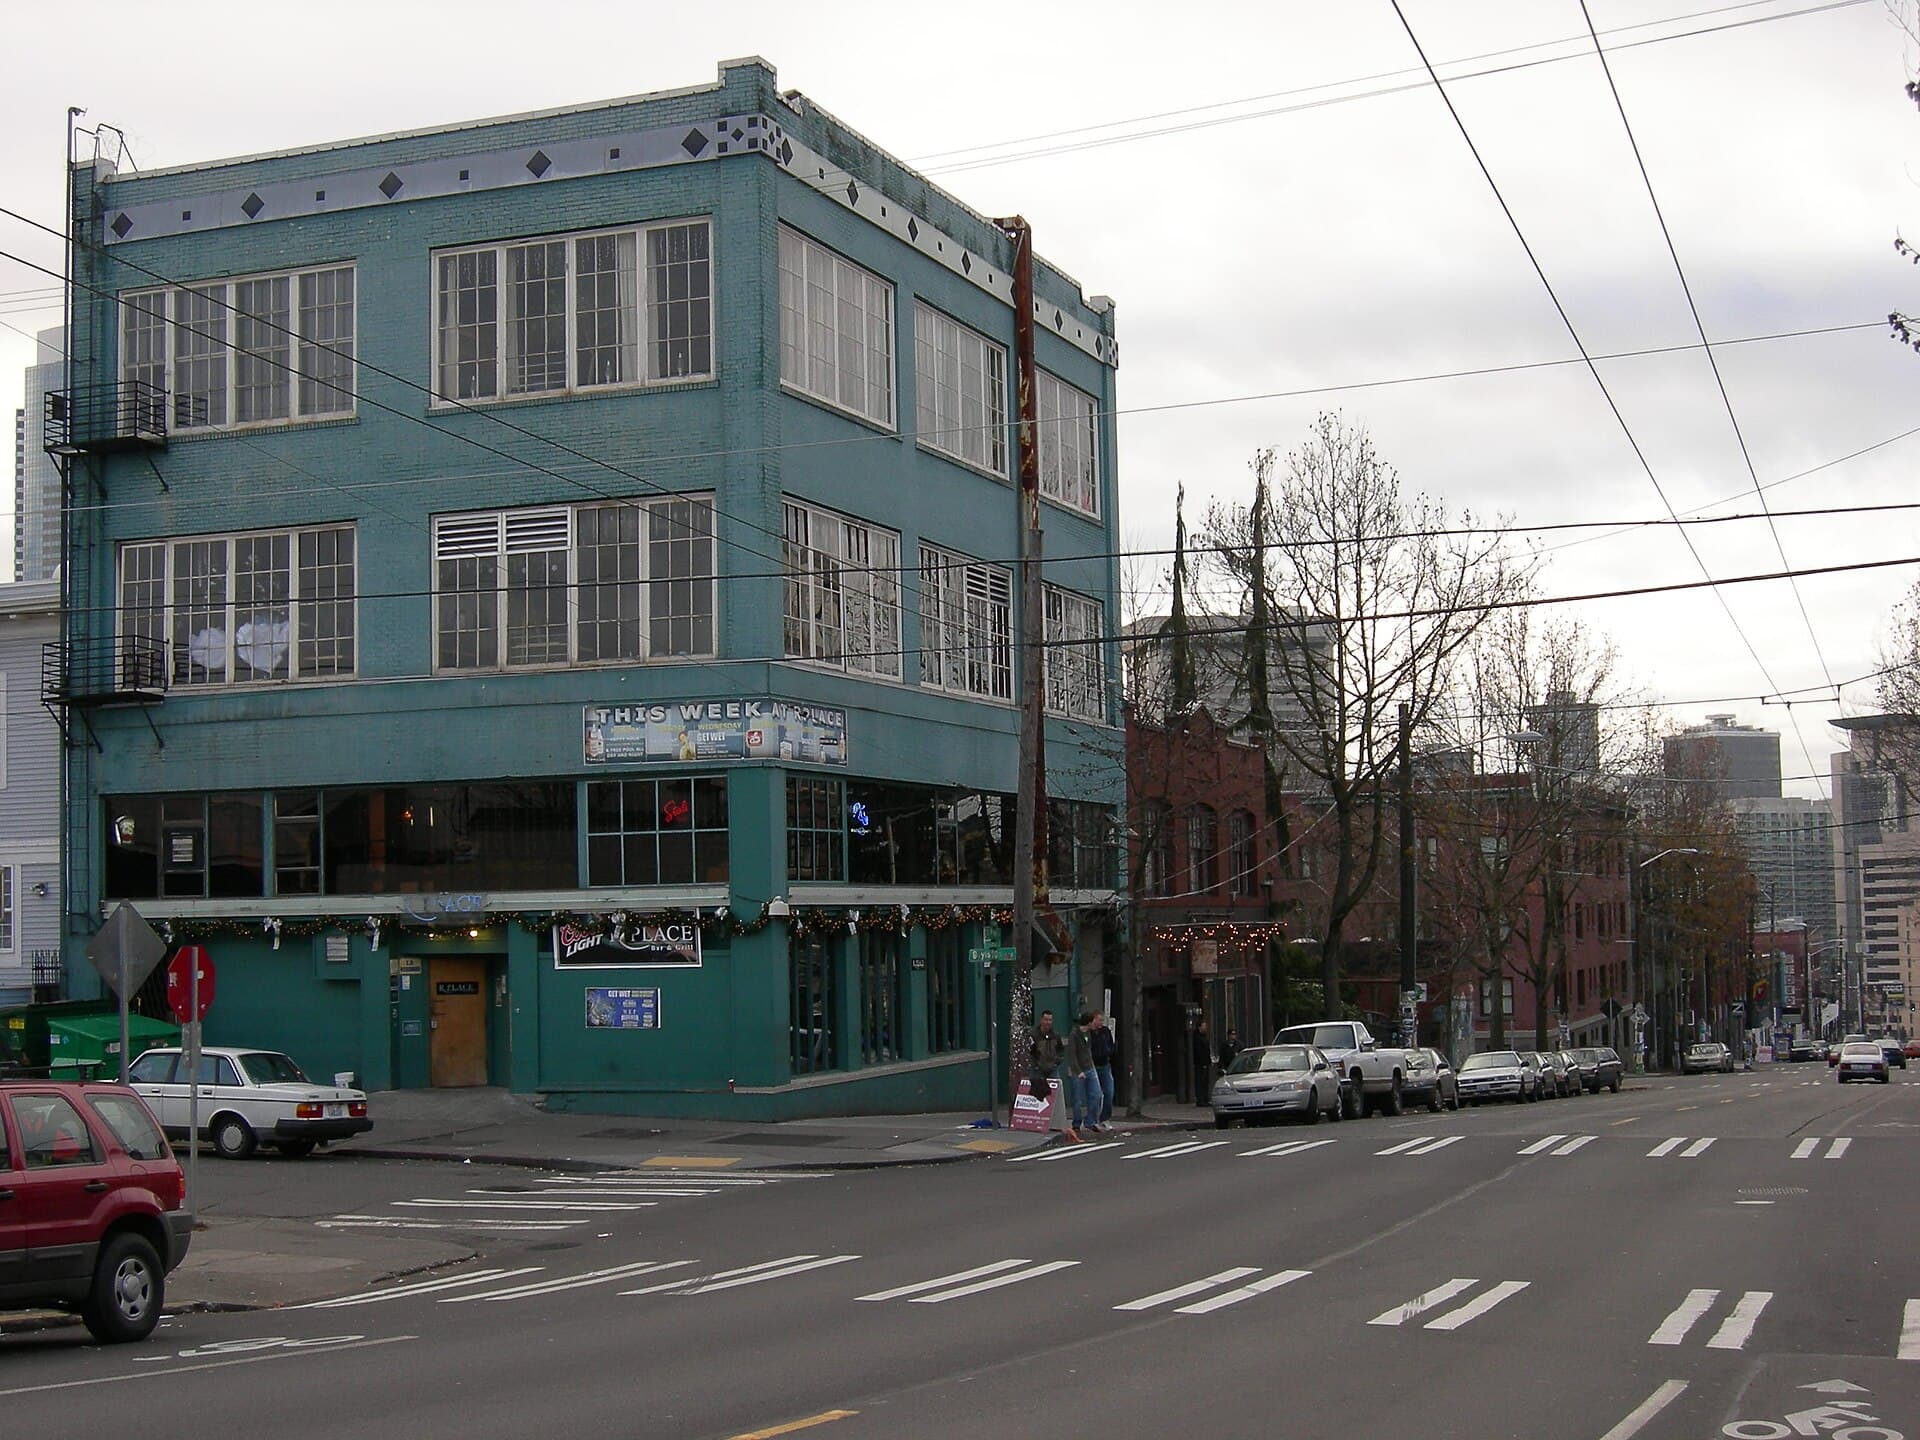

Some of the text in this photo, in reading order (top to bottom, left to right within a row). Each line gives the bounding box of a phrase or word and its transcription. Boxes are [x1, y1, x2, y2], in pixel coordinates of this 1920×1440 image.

[596, 705, 667, 724] THIS
[680, 702, 761, 721] WEEK
[772, 702, 788, 720] AT
[566, 934, 604, 957] LIGHT
